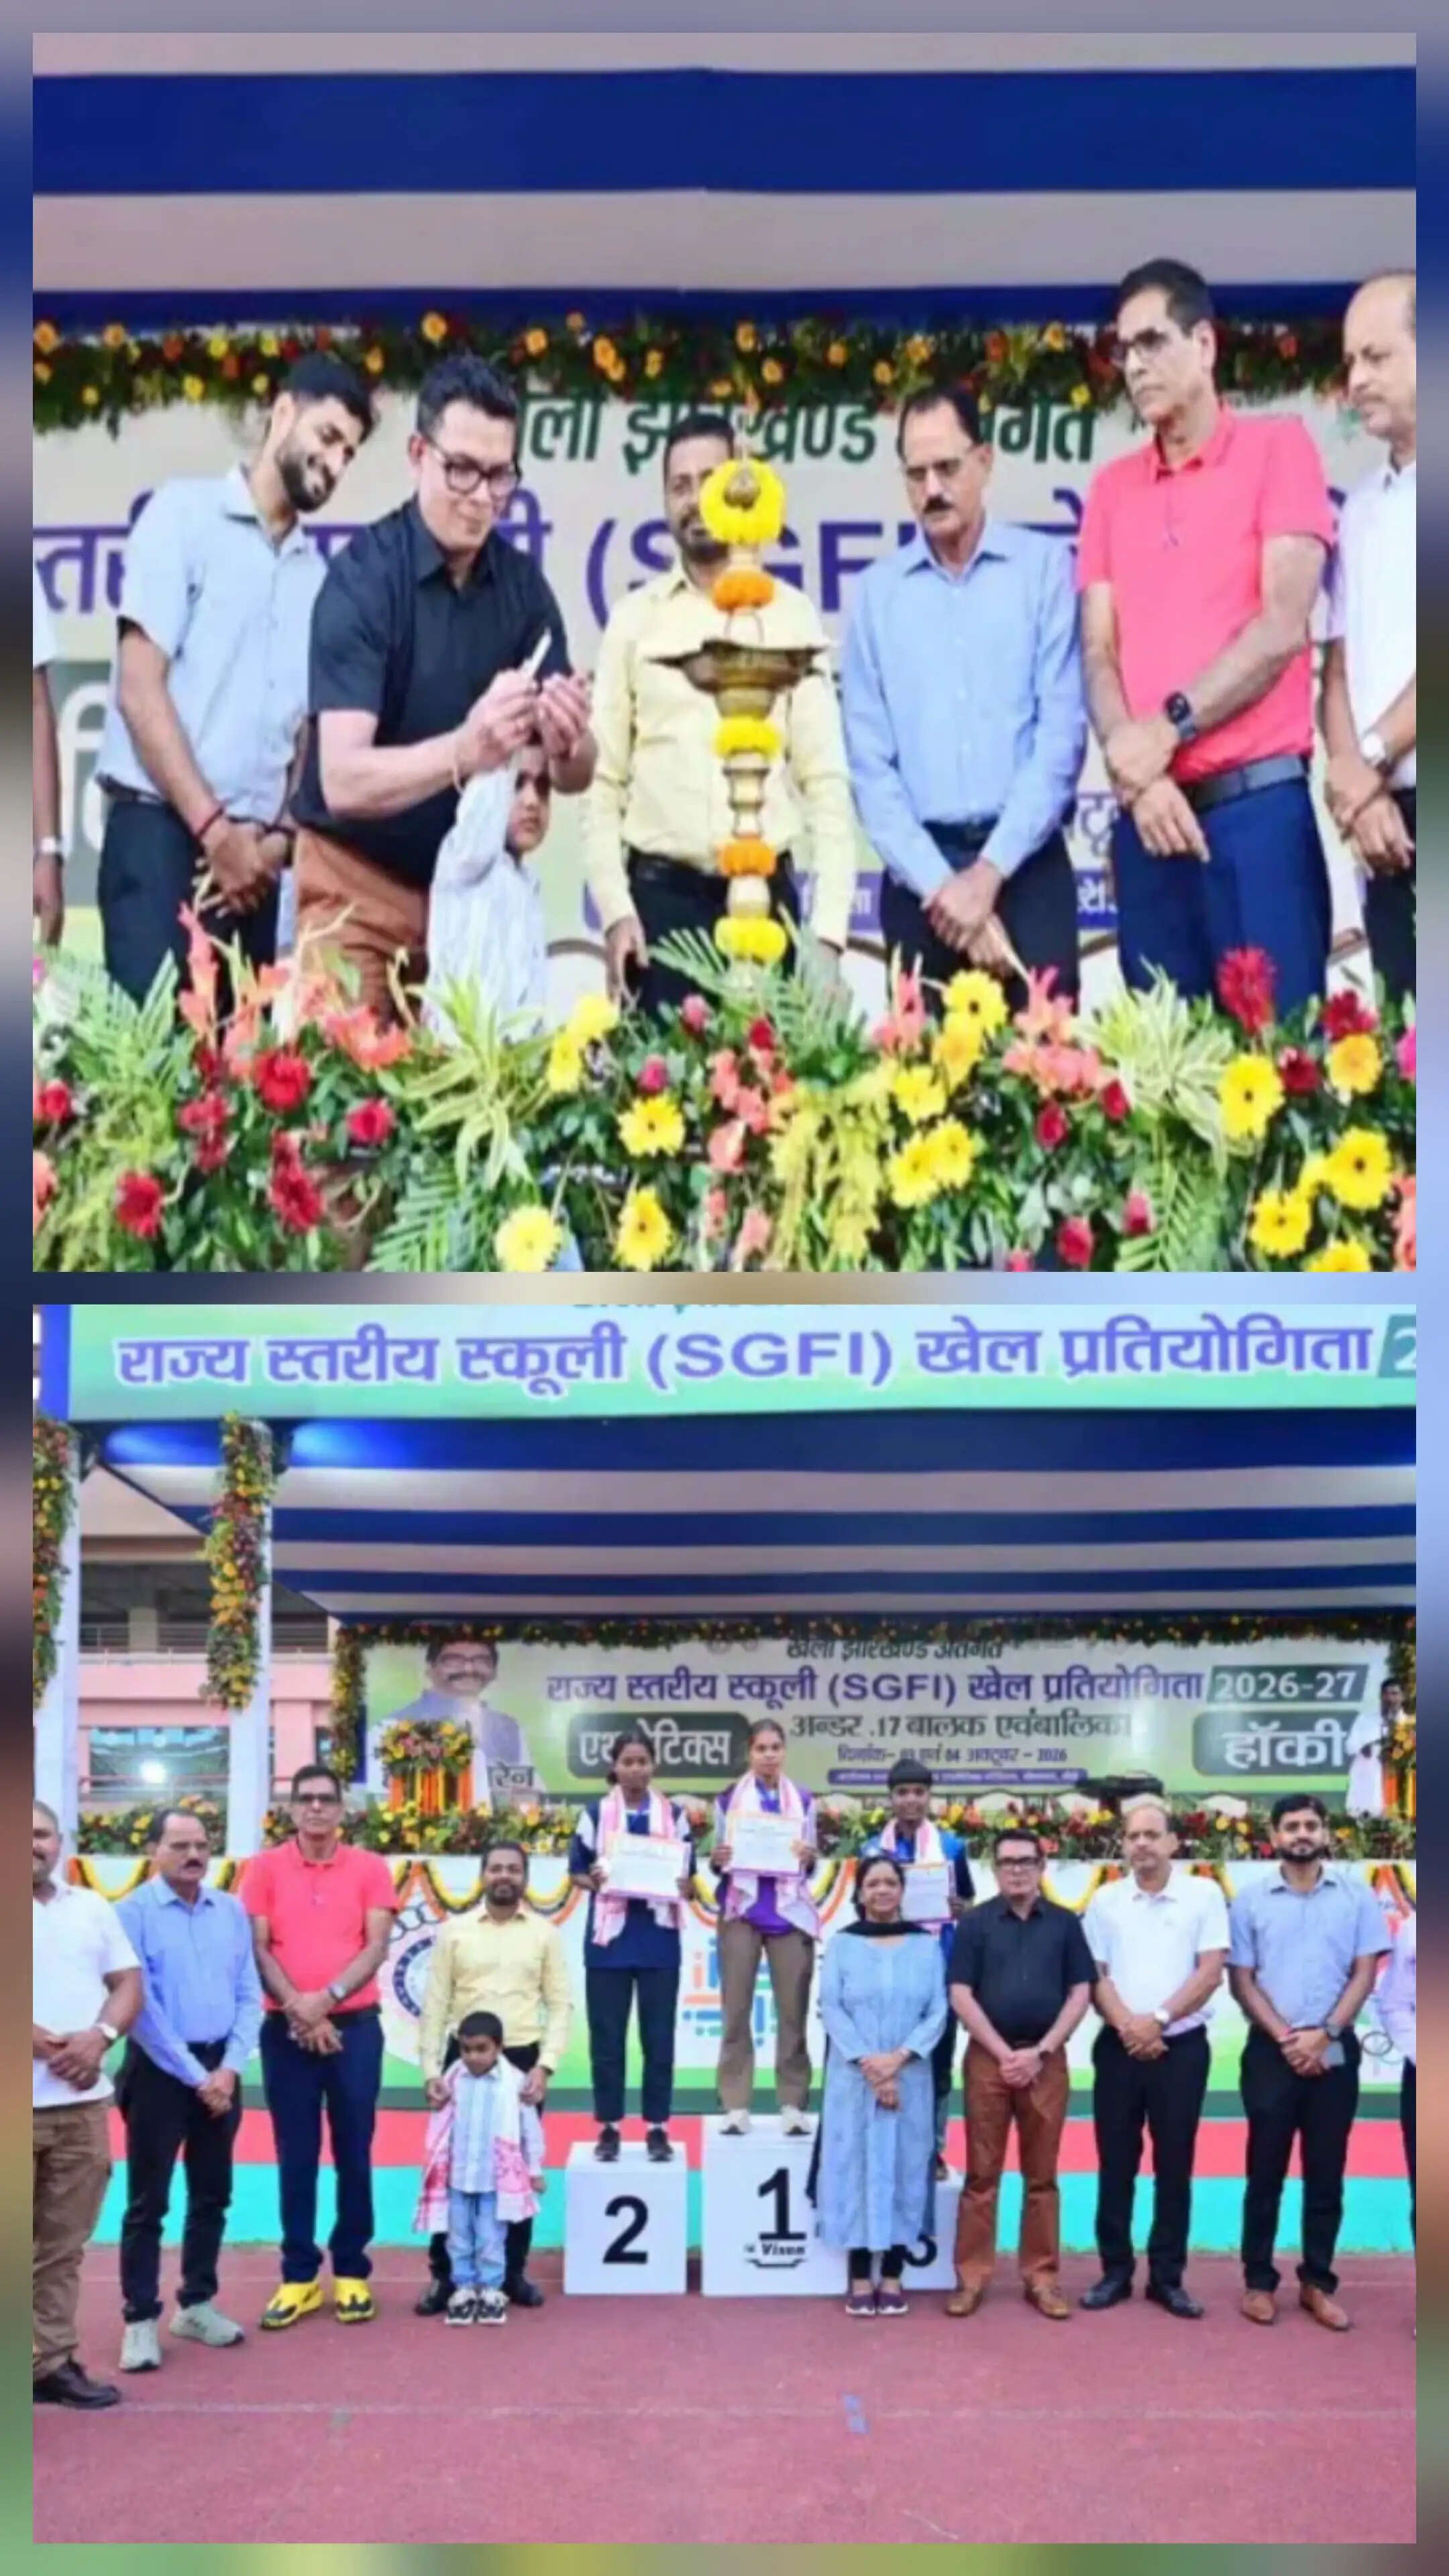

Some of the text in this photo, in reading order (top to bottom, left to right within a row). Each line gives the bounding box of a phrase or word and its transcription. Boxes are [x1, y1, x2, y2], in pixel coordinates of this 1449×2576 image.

[117, 1340, 250, 1383] राज्य
[267, 1324, 439, 1383] स्तरीय
[456, 1319, 628, 1396] स्कूली
[647, 1331, 892, 1389] (SGFI)
[915, 1315, 1042, 1373] खेल
[1060, 1313, 1373, 1375] प्रतियोगिता
[547, 1664, 1357, 1710] राज्य स्तरीय स्कूली (SGFI) खेल प्रतियोगिता 2026-27
[906, 1714, 988, 1738] बालक
[1221, 1717, 1346, 1770] हॉकी
[602, 2196, 649, 2264] 2
[757, 2167, 807, 2240] 1
